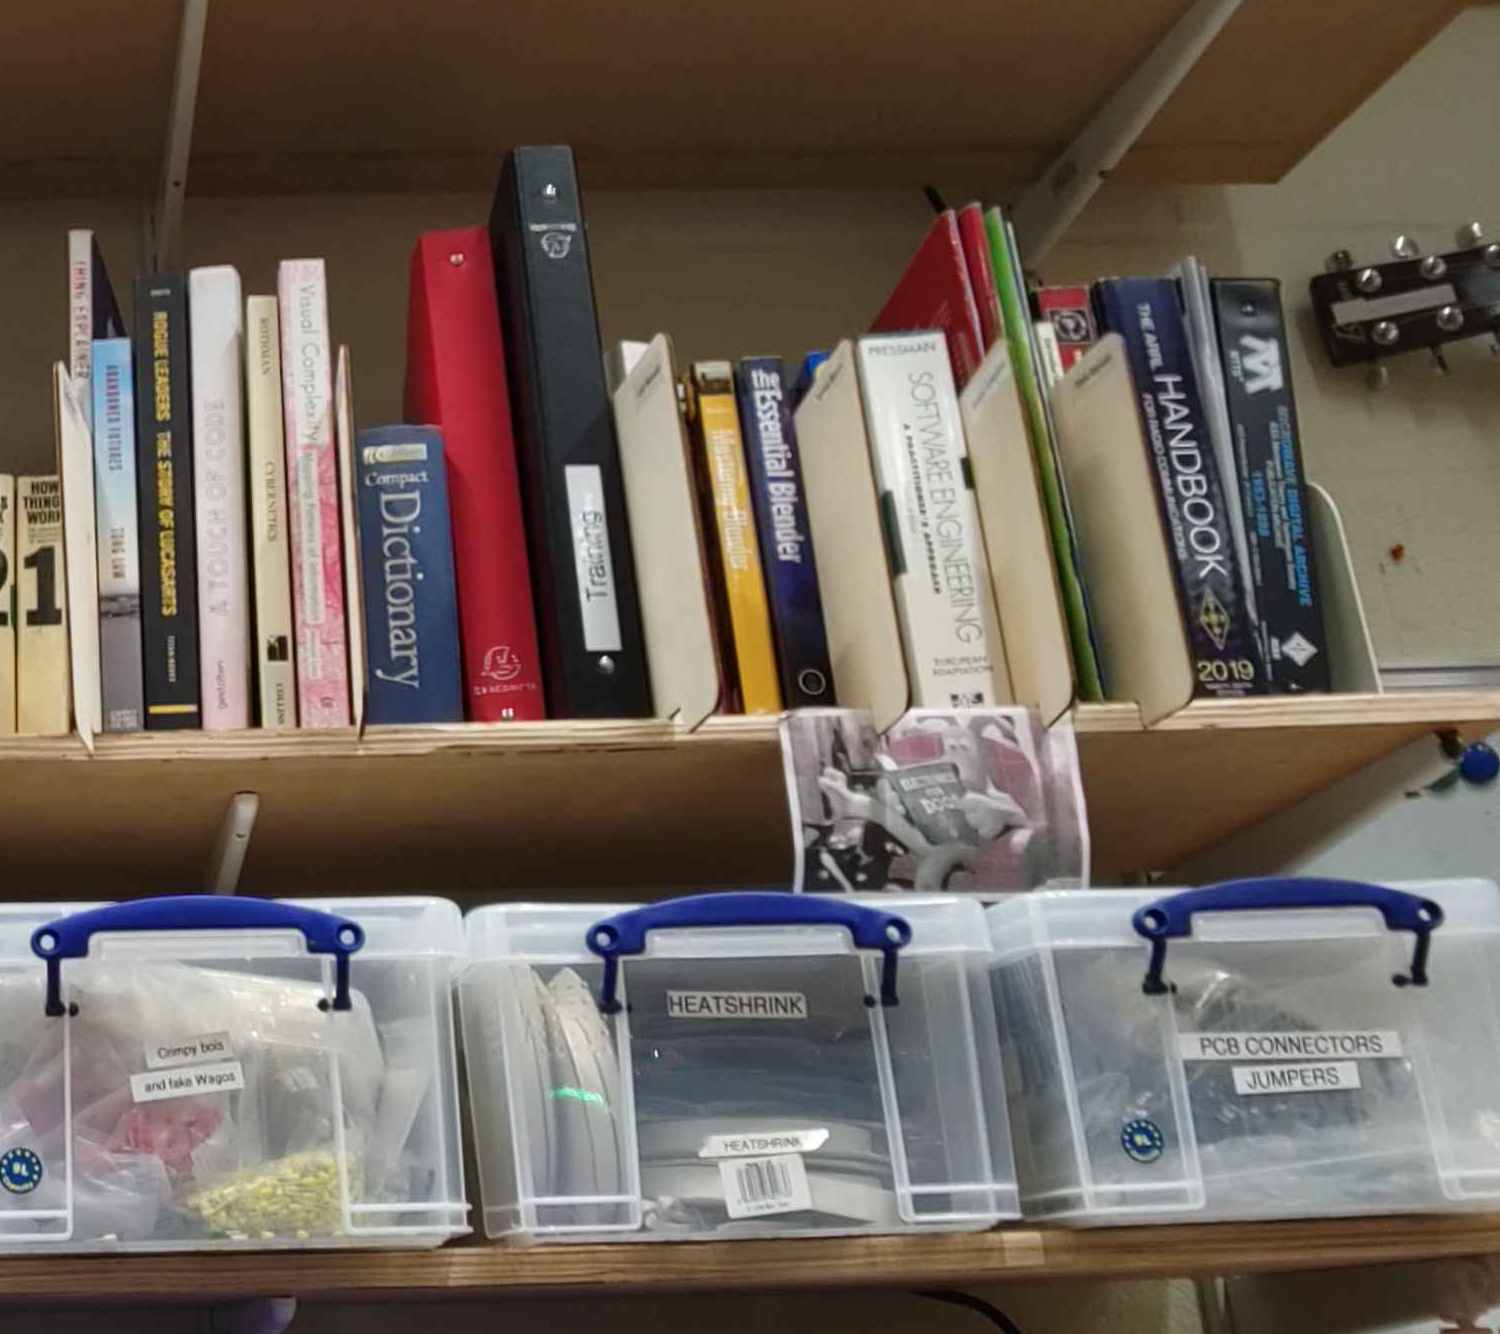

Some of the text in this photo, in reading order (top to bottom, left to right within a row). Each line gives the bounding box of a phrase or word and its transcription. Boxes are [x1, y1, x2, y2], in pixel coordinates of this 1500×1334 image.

[152, 311, 168, 357] ROGUE
[867, 341, 938, 356] PRESSMAN
[296, 283, 324, 442] Visual Complexity
[153, 360, 169, 420] LEADERS
[157, 431, 171, 457] THE
[203, 402, 227, 457] CODE
[31, 480, 59, 494] HOW
[157, 460, 173, 506] STORY
[207, 465, 227, 502] OF
[363, 470, 429, 487] Compact
[752, 369, 806, 564] the Essential Blender
[1154, 373, 1229, 577] HANDBOOK
[158, 510, 173, 528] OF
[908, 371, 946, 485] SOFTWARE
[932, 487, 985, 643] ENGINEERING
[211, 512, 229, 591] TOUCH
[582, 509, 611, 603] Training
[24, 546, 62, 626] 1
[375, 488, 423, 692] Dictionary
[1292, 544, 1314, 606] ARCHIVE
[1198, 659, 1254, 682] 2019
[669, 994, 803, 1015] HEATSHRINK
[157, 1038, 225, 1061] Crimpy bois
[1200, 1035, 1383, 1055] PCB CONNECTORS
[144, 1069, 236, 1093] and fake Wagos
[1245, 1067, 1341, 1088] JUMPERS
[724, 1137, 802, 1152] HEATSHRINK
